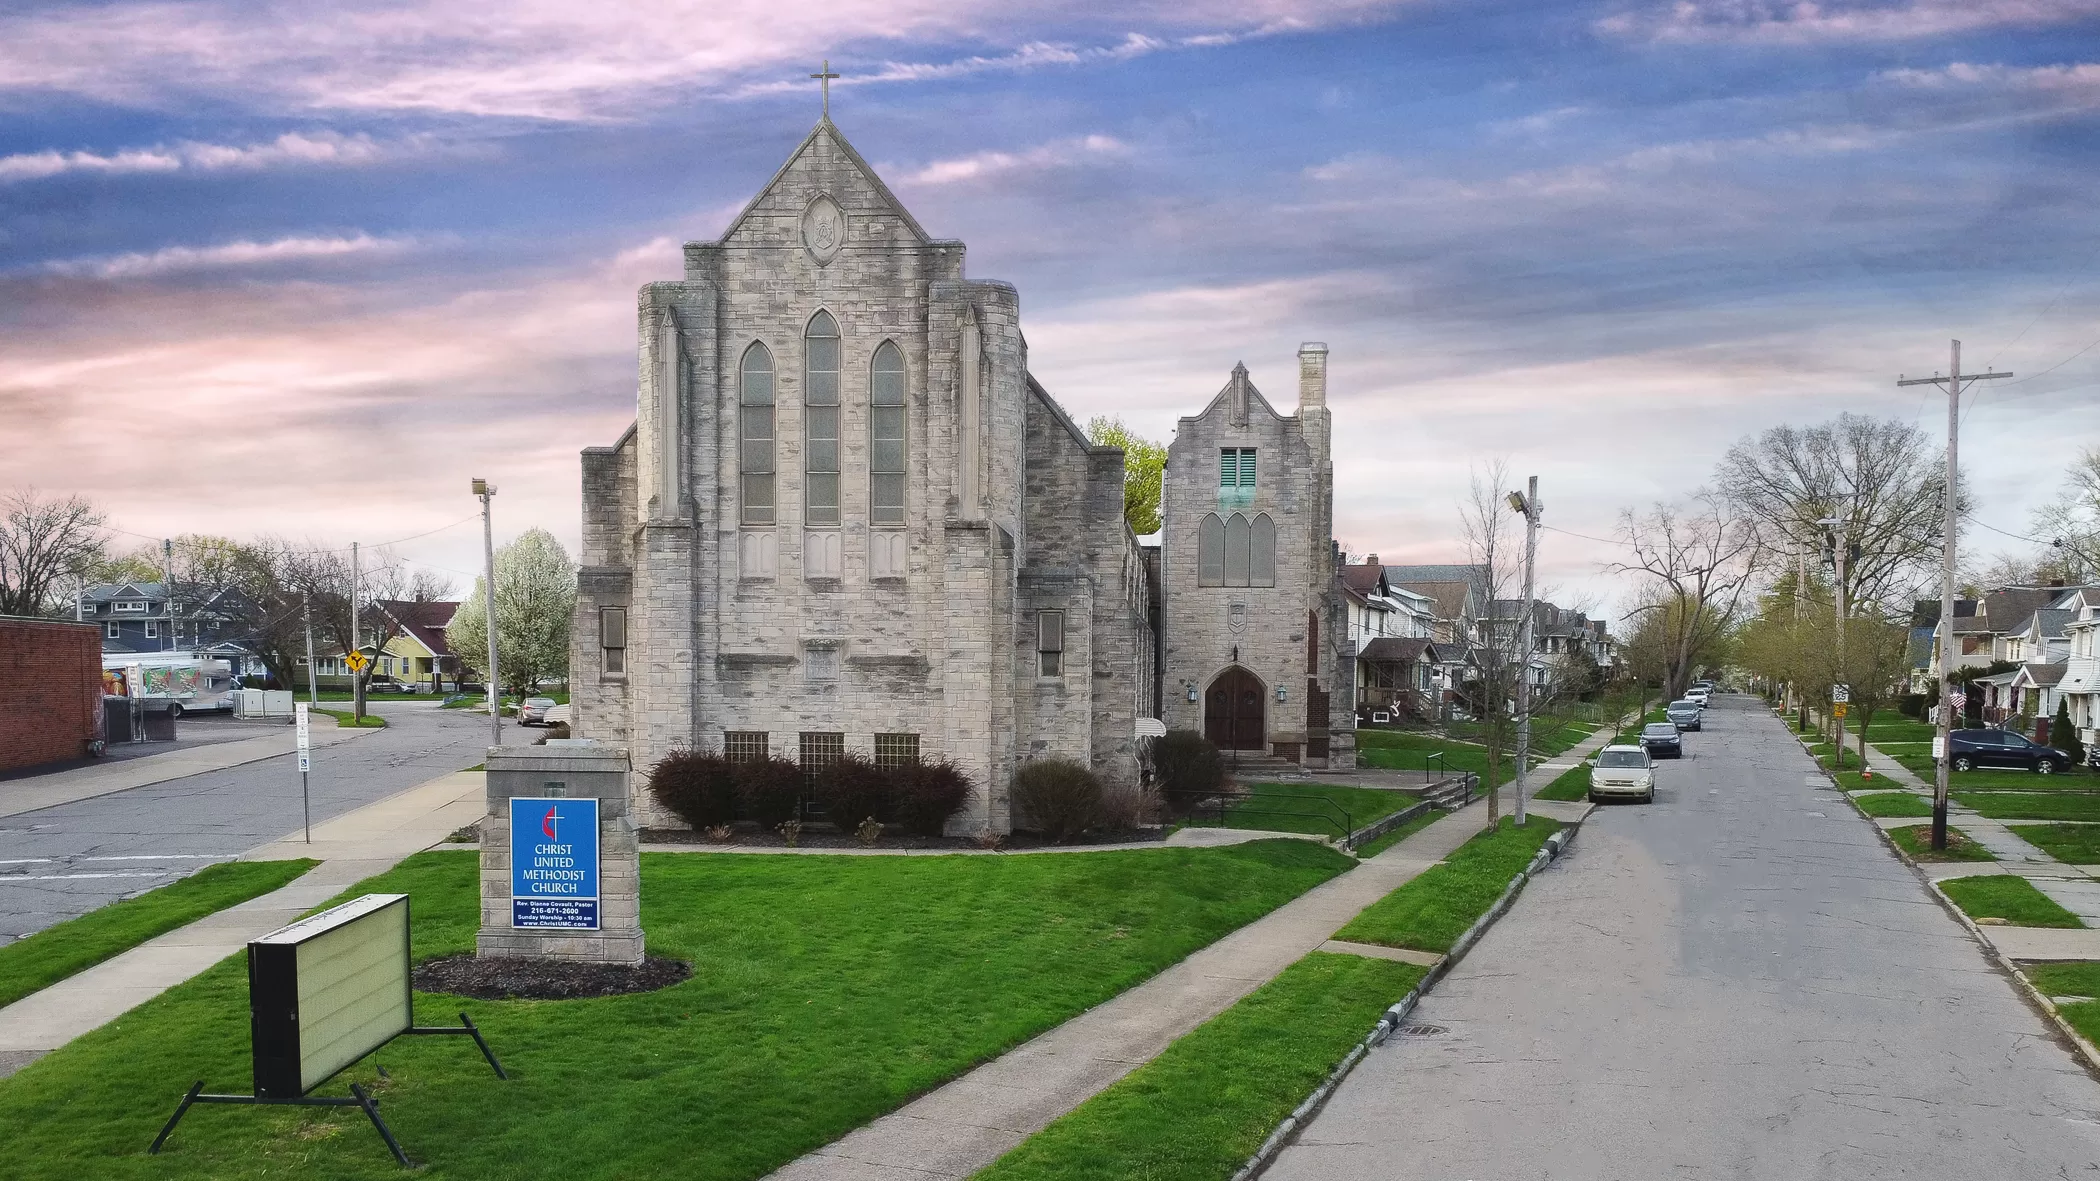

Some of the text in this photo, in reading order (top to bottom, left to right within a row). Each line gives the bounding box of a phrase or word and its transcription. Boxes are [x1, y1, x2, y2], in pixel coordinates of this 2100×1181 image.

[535, 844, 573, 855] CHRIST
[534, 857, 574, 868] UNITED
[523, 870, 586, 881] METHODIST
[531, 882, 577, 893] CHURCH
